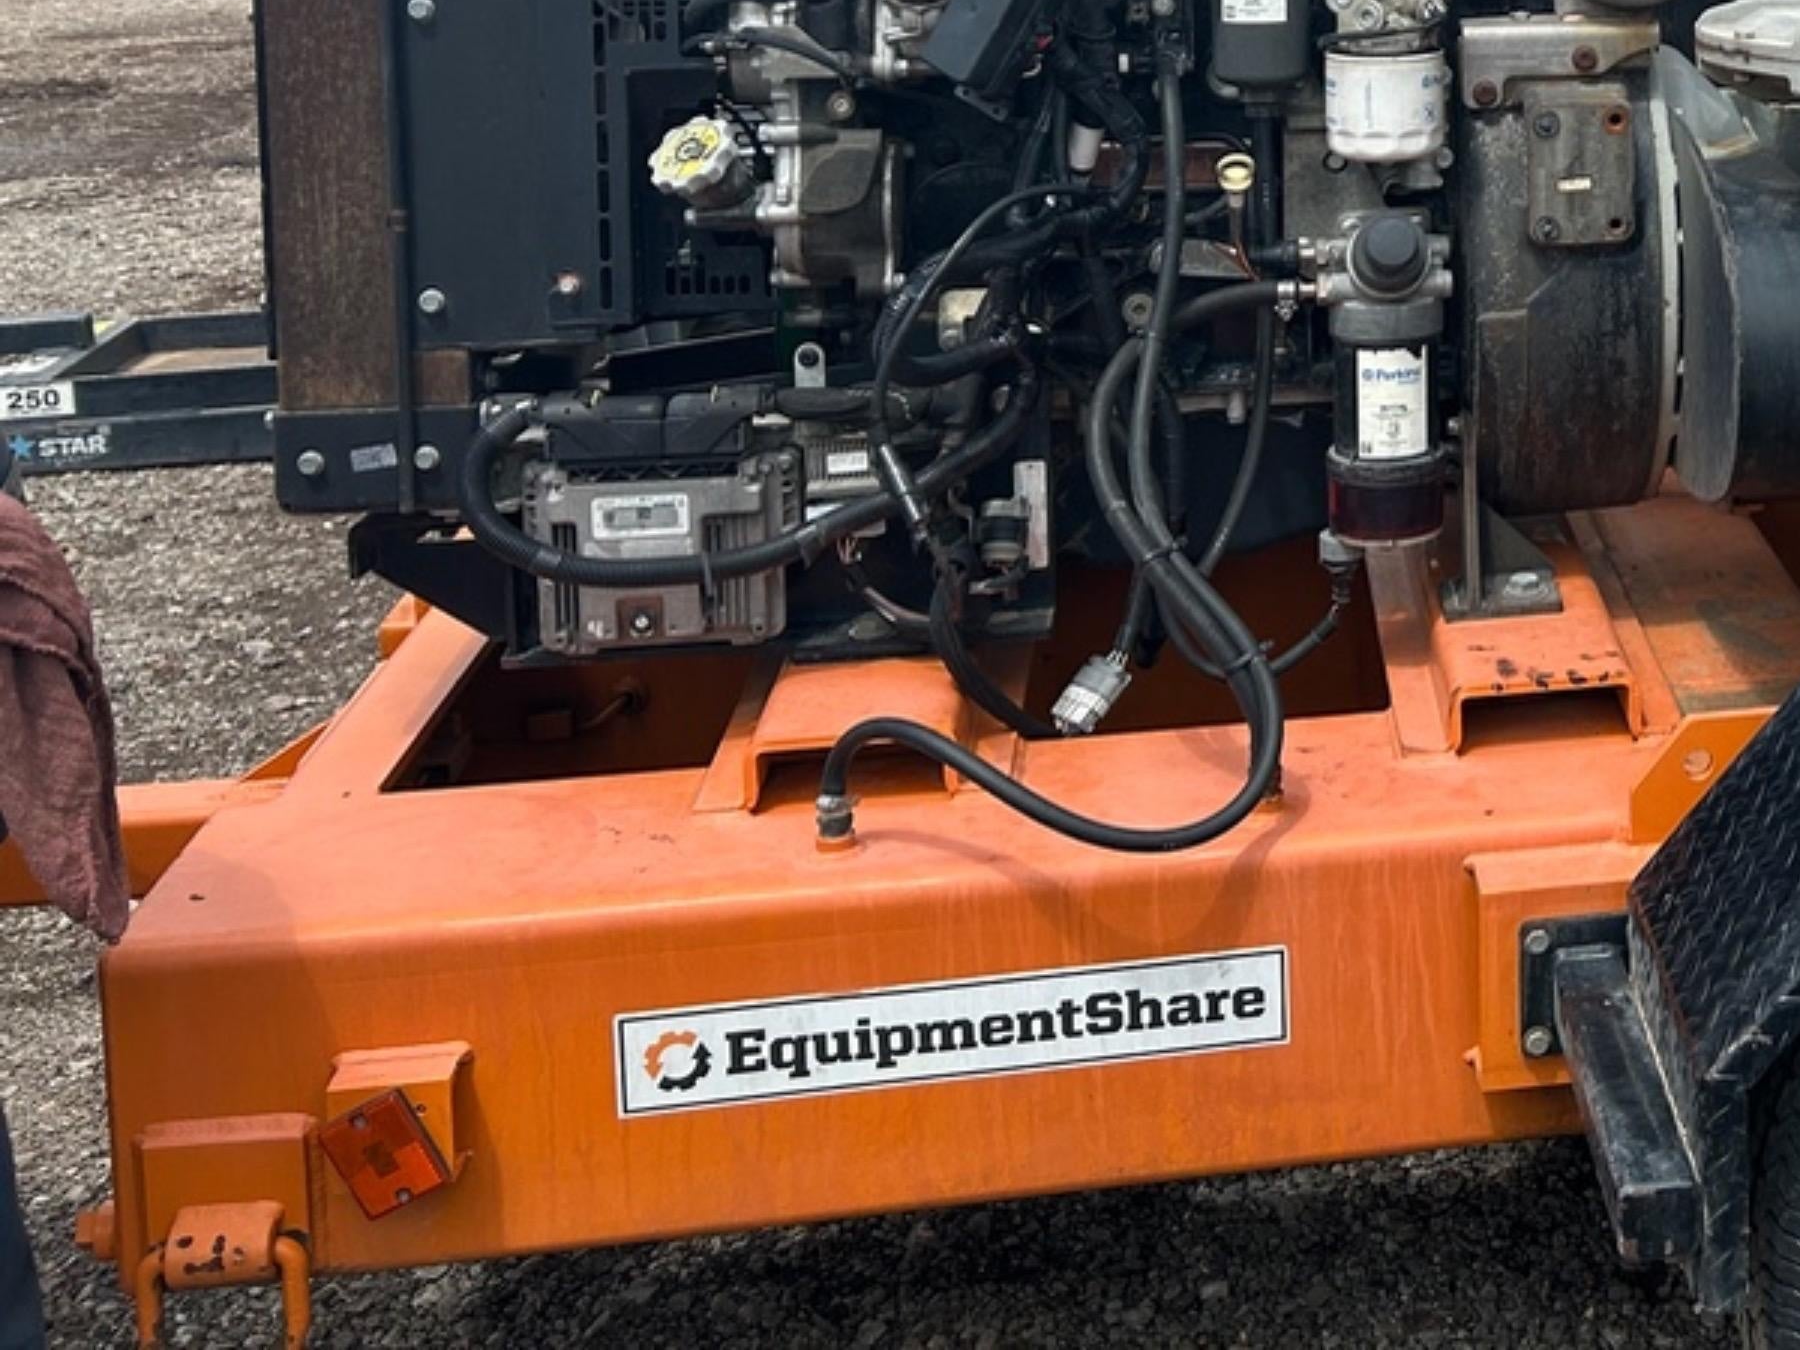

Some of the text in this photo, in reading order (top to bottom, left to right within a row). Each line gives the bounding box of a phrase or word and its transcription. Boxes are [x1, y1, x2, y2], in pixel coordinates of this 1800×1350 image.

[6, 389, 60, 409] 250
[39, 434, 107, 458] STAR
[725, 986, 1267, 1078] EquipmentShare
